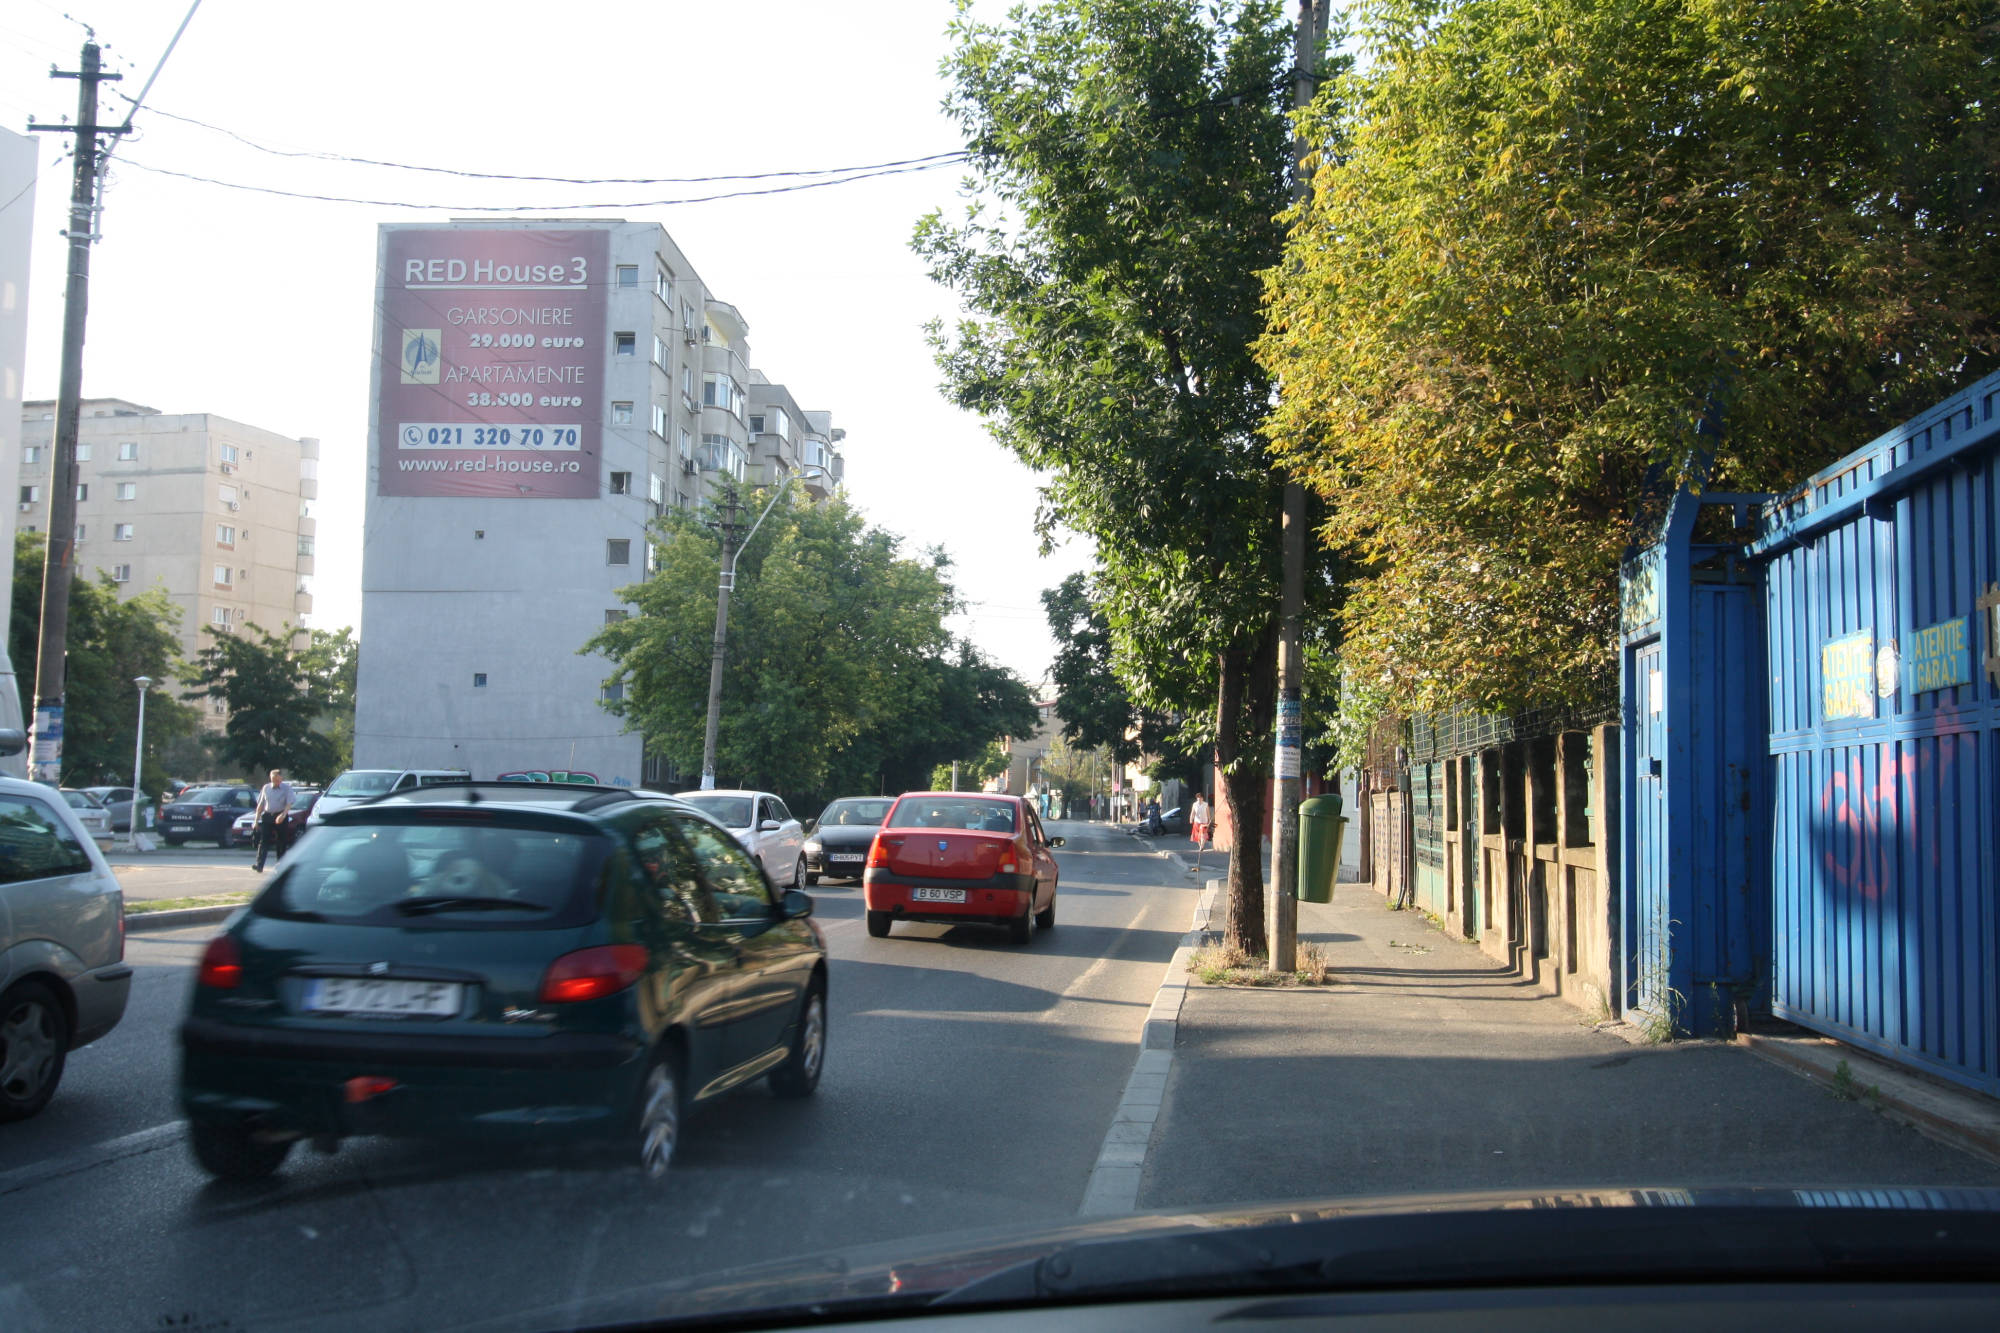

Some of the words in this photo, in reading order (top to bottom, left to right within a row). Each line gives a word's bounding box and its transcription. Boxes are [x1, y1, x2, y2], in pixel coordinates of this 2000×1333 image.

[405, 259, 467, 282] RED
[474, 258, 565, 283] House
[568, 256, 588, 284] 3
[447, 307, 573, 326] GARSONIERE
[469, 333, 536, 348] 29.000
[542, 336, 585, 348] euro
[444, 366, 585, 384] APARTAMENTE
[467, 392, 534, 407] 38.000
[540, 395, 583, 407] euro
[427, 427, 462, 445] 021
[474, 427, 511, 446] 320
[520, 428, 544, 446] 70
[553, 428, 577, 446] 70
[399, 455, 581, 473] www.red-house.ro
[1915, 620, 1964, 661] ATENTIE
[1822, 637, 1873, 681] ATENTIE
[1917, 655, 1957, 690] GARAJ
[920, 889, 927, 897] B
[930, 889, 941, 898] 60
